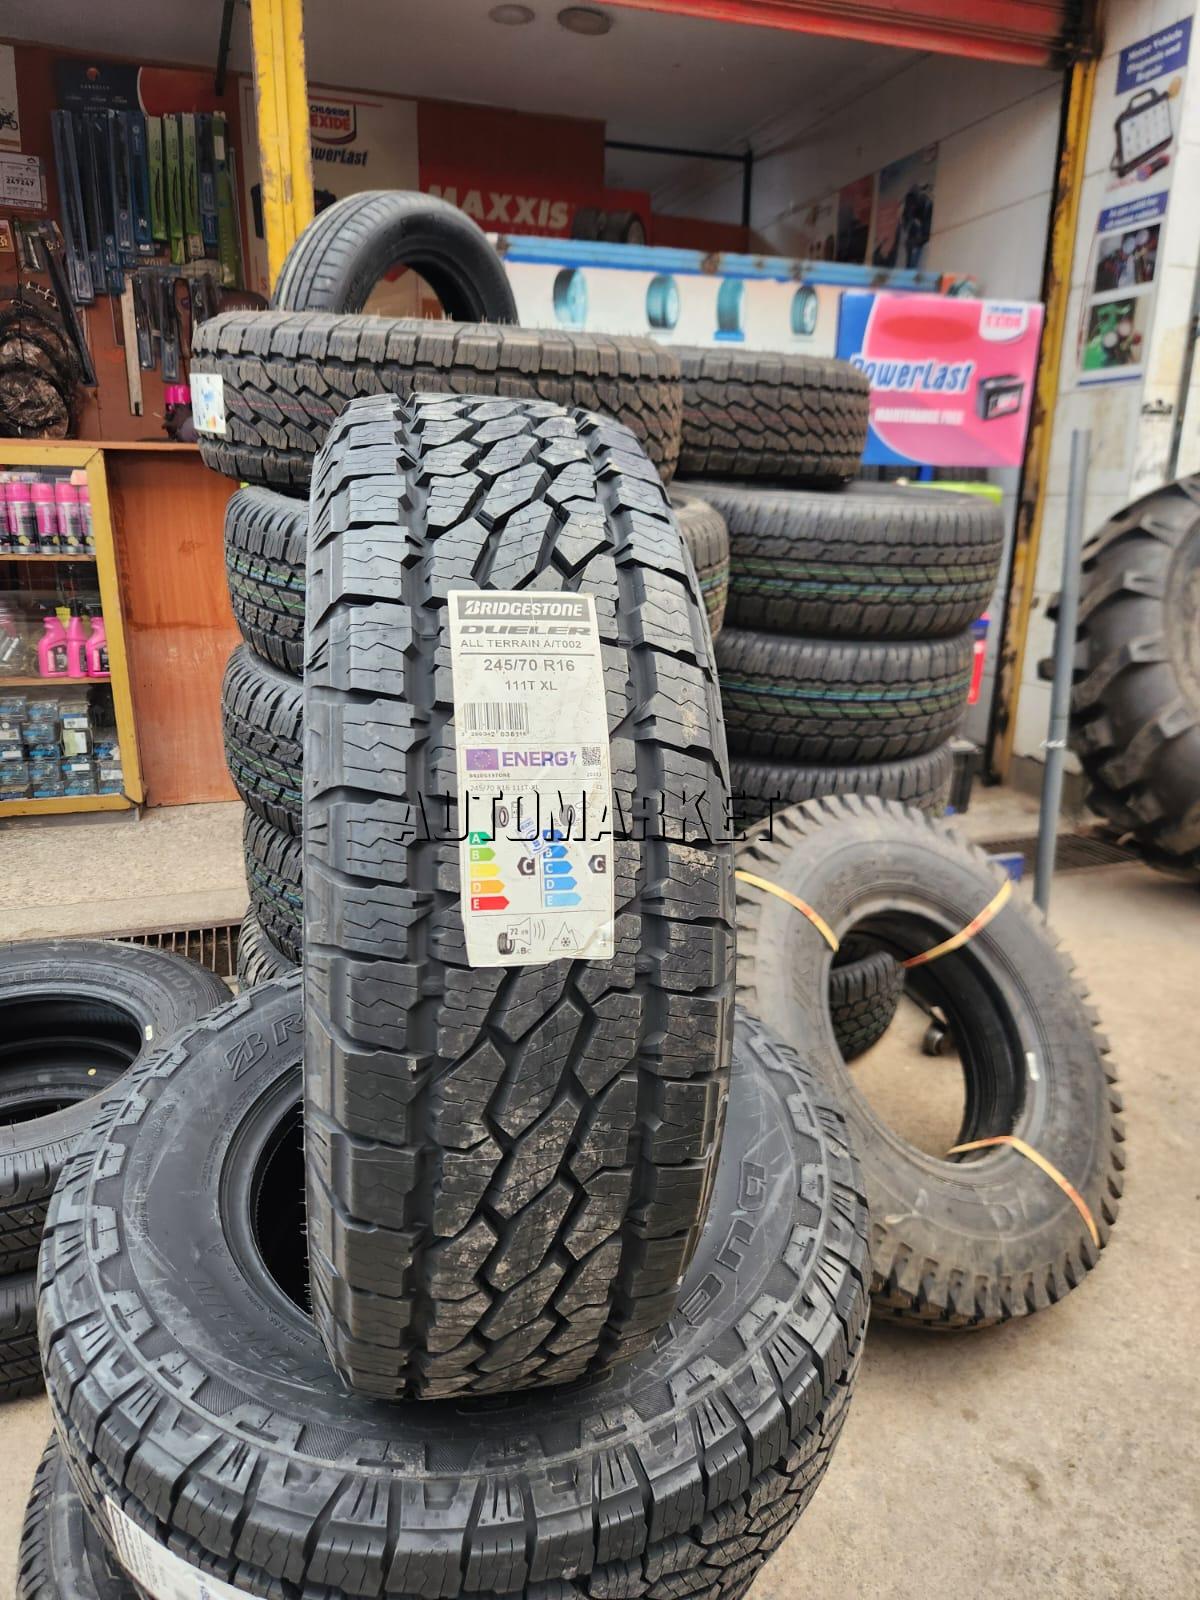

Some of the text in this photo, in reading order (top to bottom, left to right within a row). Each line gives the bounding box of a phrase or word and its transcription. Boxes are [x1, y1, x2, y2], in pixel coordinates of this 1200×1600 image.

[310, 112, 352, 131] EXIDE
[310, 146, 369, 168] werLast
[427, 184, 570, 230] MAXXIS
[464, 600, 583, 617] BRIDGESTONE
[459, 625, 592, 636] DUELER
[460, 639, 582, 649] ALL TERRAIN A/T002
[483, 659, 575, 672] 245/70 R16
[505, 680, 558, 691] 111T XL
